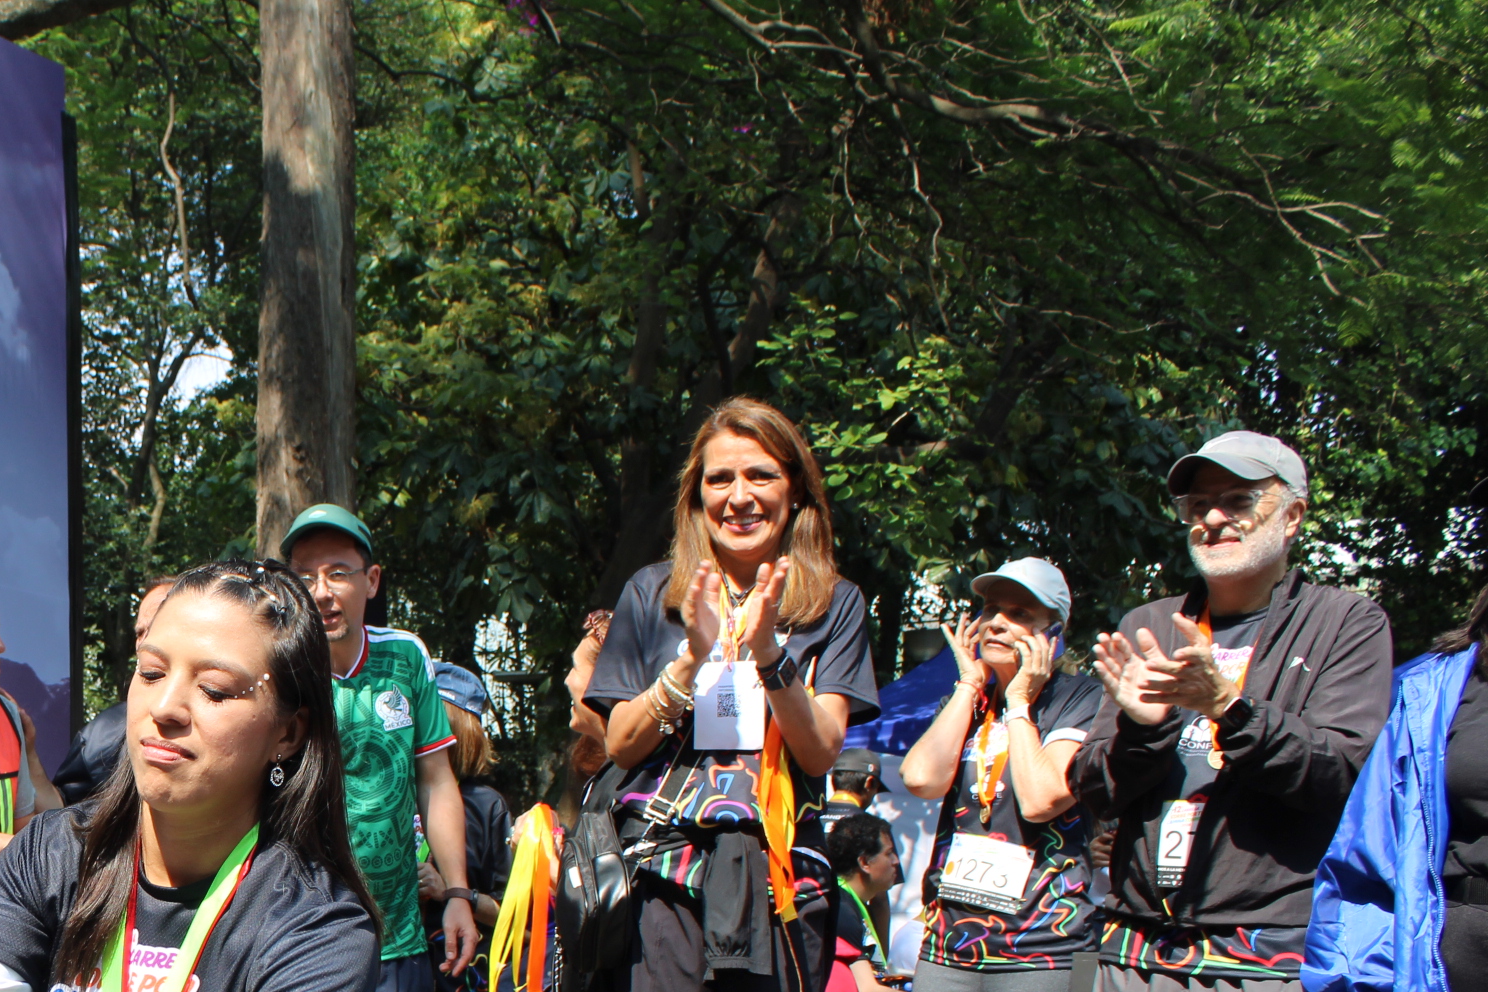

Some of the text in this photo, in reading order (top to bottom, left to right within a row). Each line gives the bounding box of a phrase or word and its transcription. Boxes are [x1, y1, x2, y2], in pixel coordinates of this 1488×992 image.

[1178, 738, 1213, 750] CONF
[955, 858, 1008, 889] 1273
[129, 950, 178, 970] ARRE
